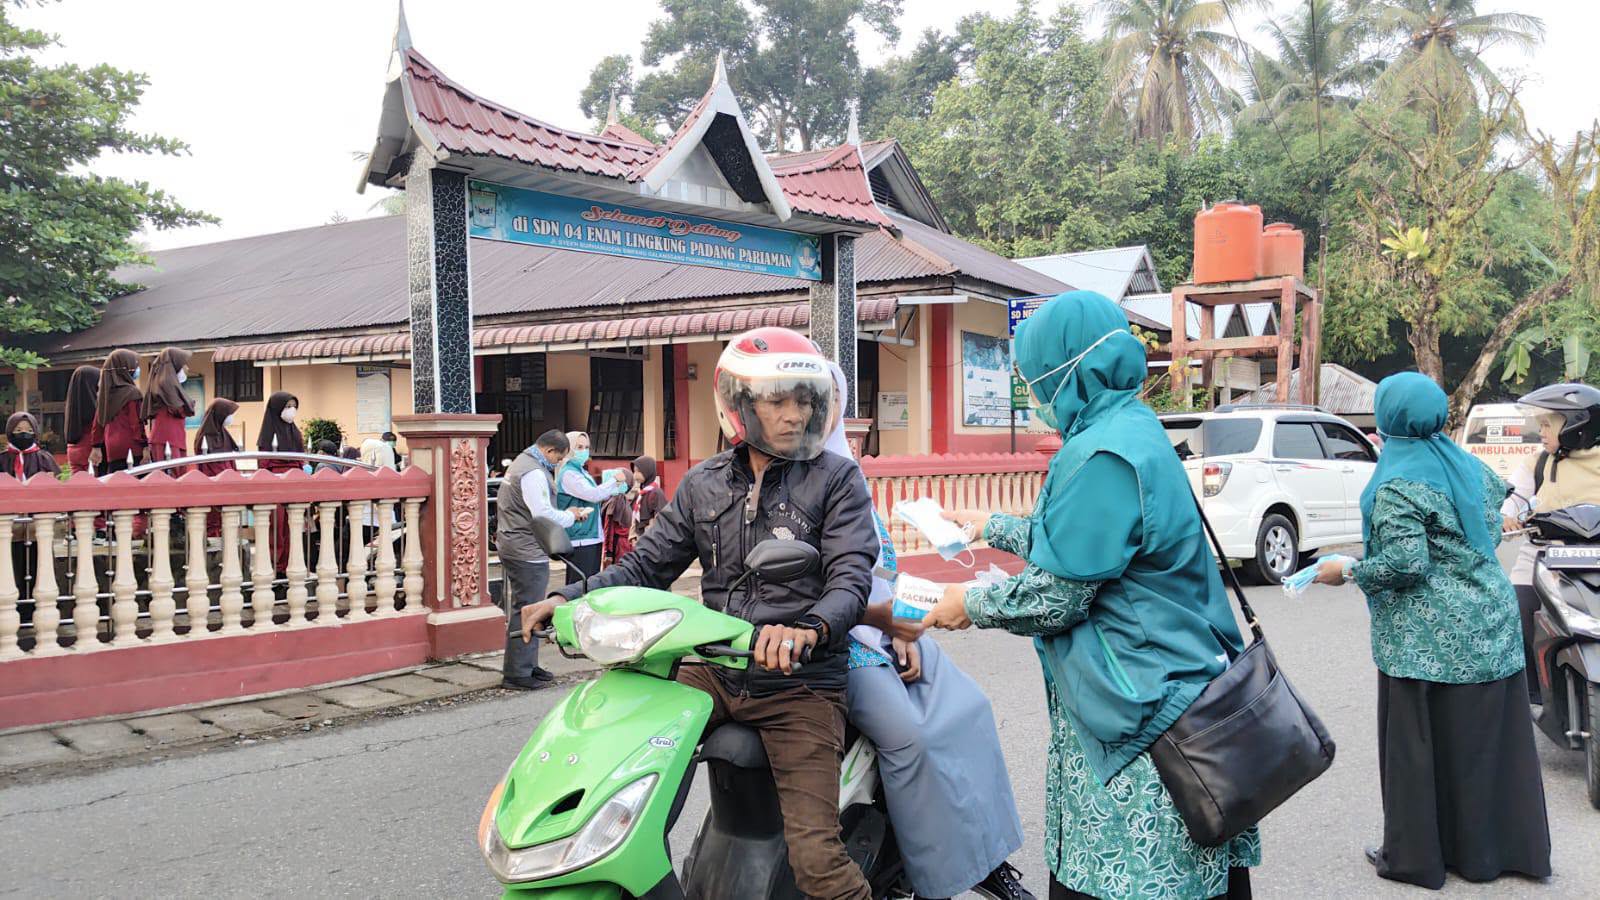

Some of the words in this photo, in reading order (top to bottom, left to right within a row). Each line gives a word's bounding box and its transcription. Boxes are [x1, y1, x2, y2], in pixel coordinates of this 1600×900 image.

[513, 216, 528, 232] di
[533, 218, 560, 236] SDN
[564, 223, 582, 240] 04
[587, 226, 622, 245] ENAM
[626, 231, 685, 254] LINGKUNG
[690, 240, 735, 261] PADANG
[739, 249, 792, 267] PARIAMAN
[782, 361, 817, 369] INK
[1471, 445, 1537, 455] AMBULANCE
[902, 592, 942, 604] FACEMA
